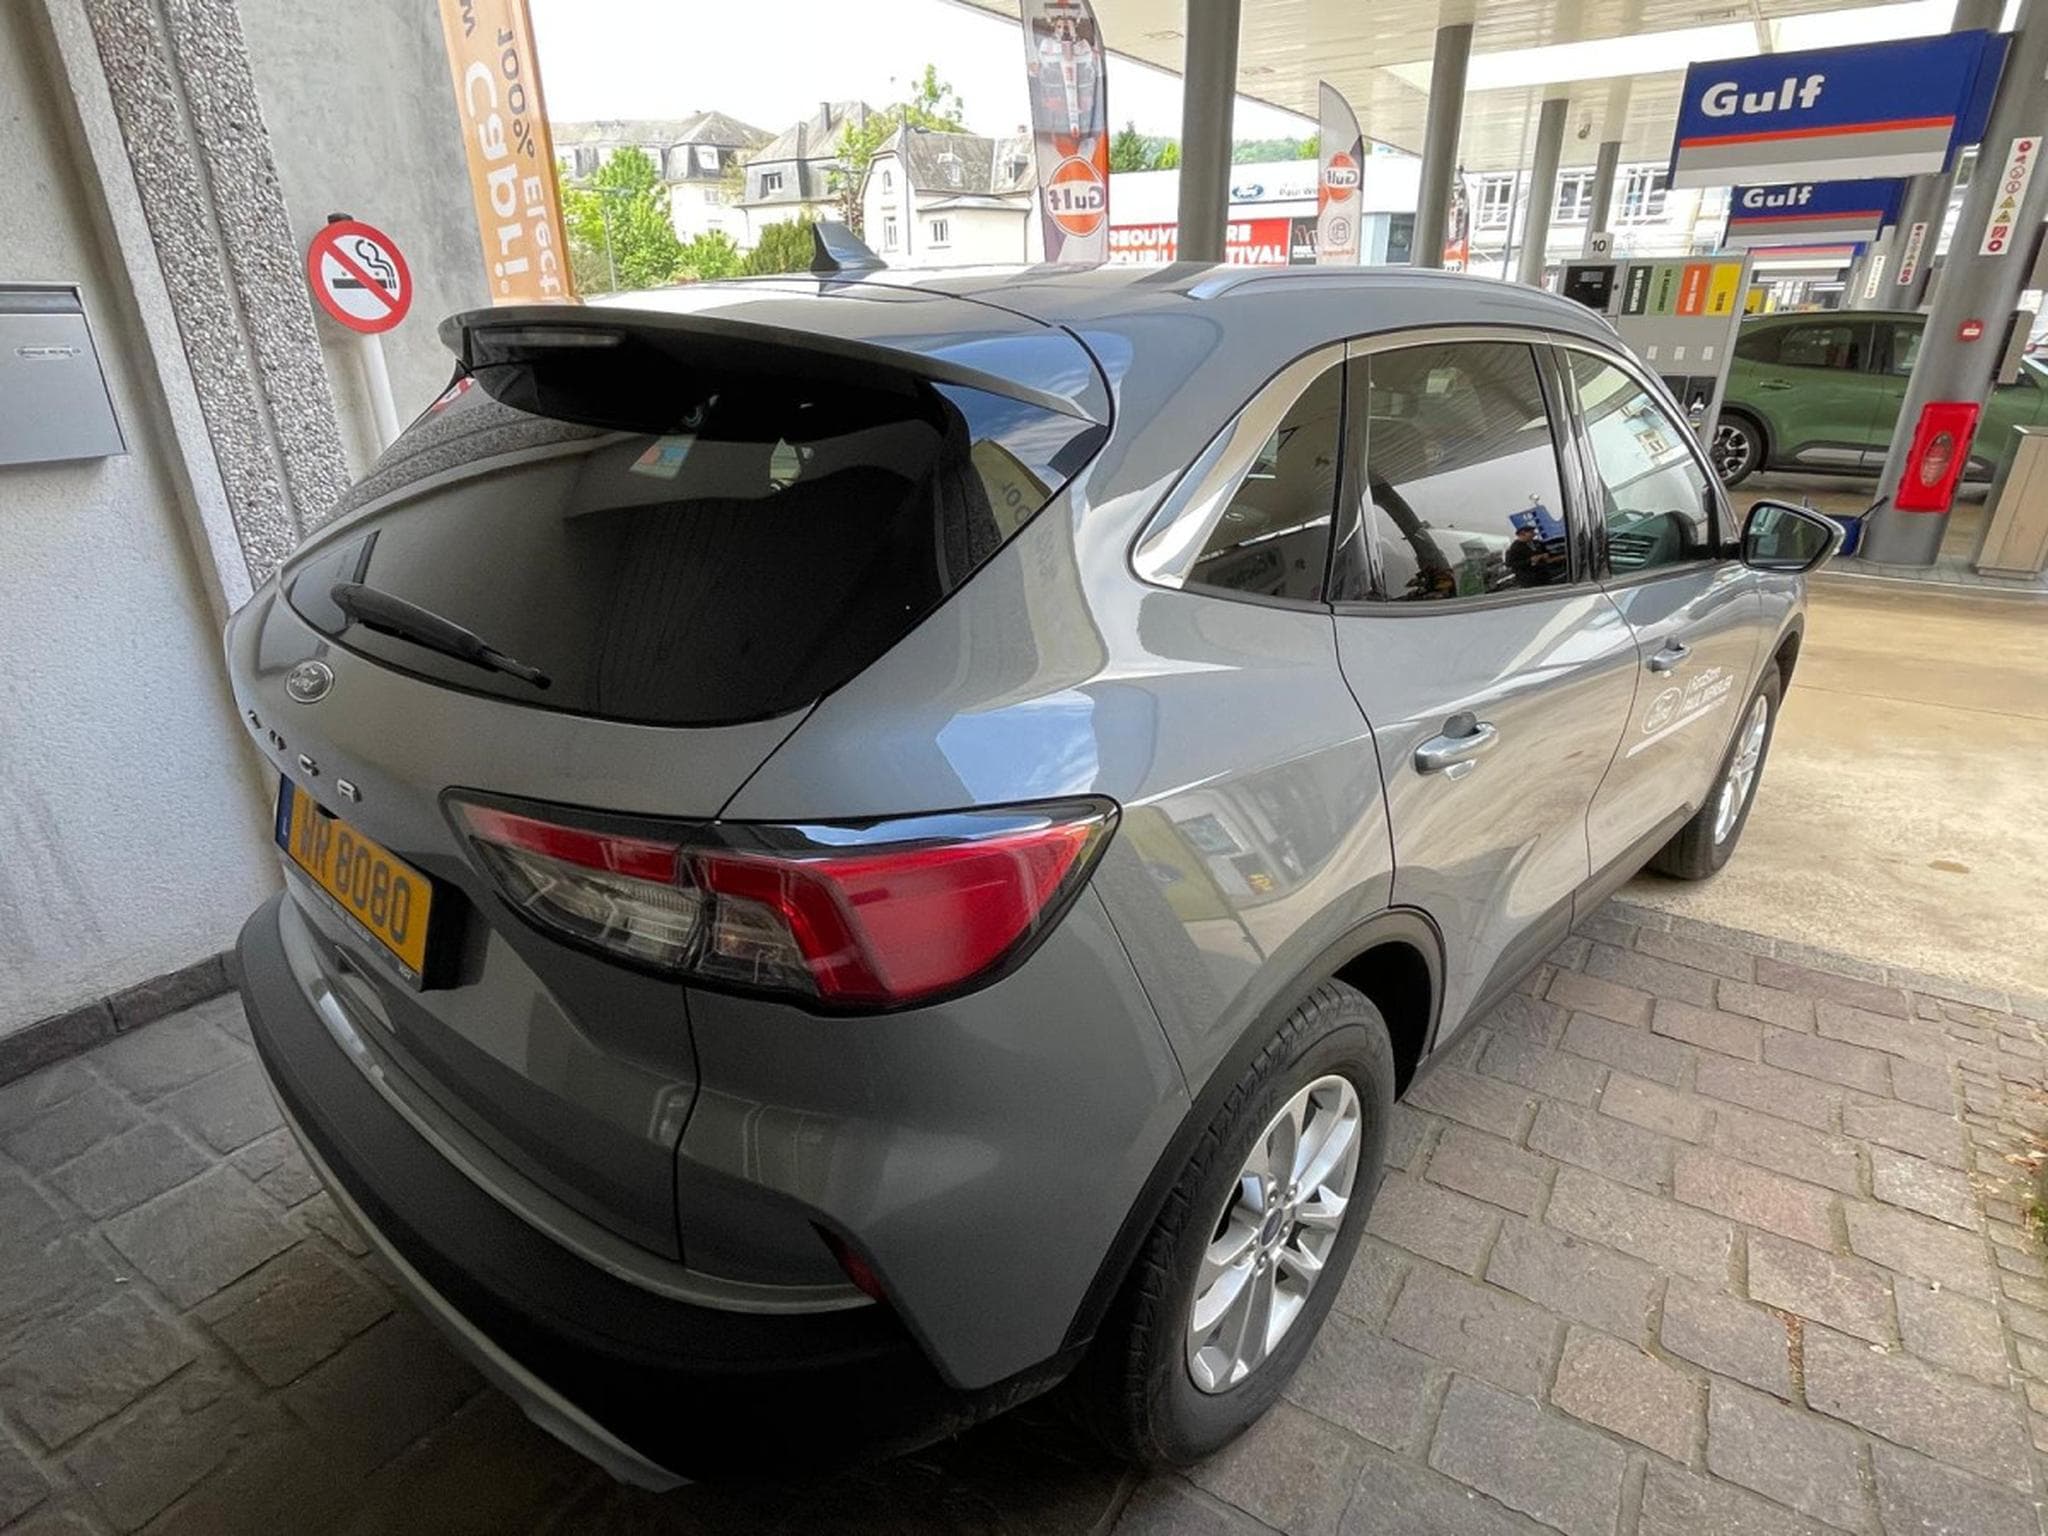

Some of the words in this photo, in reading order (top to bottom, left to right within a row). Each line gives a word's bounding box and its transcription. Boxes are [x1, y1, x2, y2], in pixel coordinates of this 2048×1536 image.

[1701, 74, 1826, 117] Gulf
[1742, 185, 1813, 208] Gulf
[1592, 239, 1606, 252] 10
[335, 831, 409, 944] 8080
